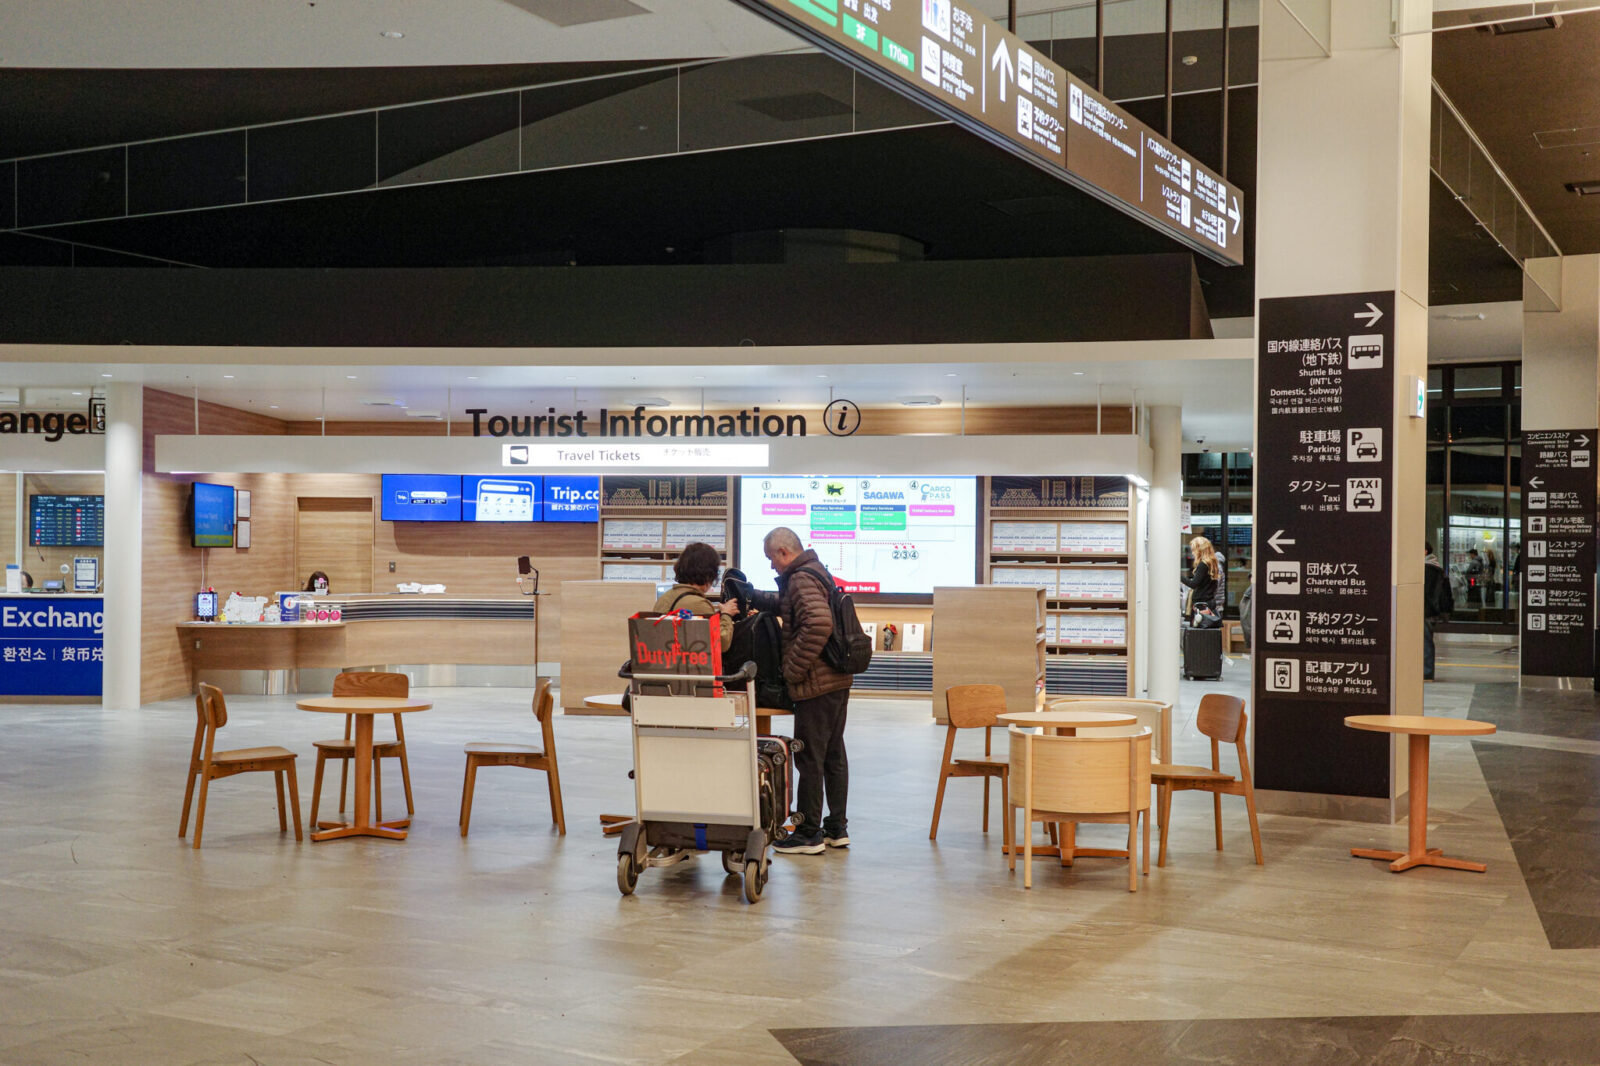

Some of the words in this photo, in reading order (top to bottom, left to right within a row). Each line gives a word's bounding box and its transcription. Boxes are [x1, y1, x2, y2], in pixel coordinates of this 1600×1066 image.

[856, 23, 866, 41] 3F
[889, 44, 908, 66] 170m
[1267, 337, 1342, 353] 国内線連絡バス
[1302, 352, 1342, 367] (地下鉄)
[1299, 369, 1326, 377] Shuttle
[1328, 368, 1342, 376] Bus
[1308, 386, 1342, 396] Subway)
[465, 408, 588, 437] Tourist
[599, 407, 807, 437] Information
[1299, 430, 1341, 444] 駐車場
[1307, 445, 1341, 454] Parking
[557, 450, 594, 461] Travel
[599, 450, 641, 461] Tickets
[1288, 480, 1340, 492] タクシー
[1349, 480, 1378, 488] TAXI
[863, 491, 905, 500] SAGAWA
[1322, 494, 1341, 502] Taxi
[1306, 562, 1359, 575] 団体バス
[1350, 578, 1366, 586] Bus
[1269, 612, 1297, 620] TAXI
[1306, 611, 1378, 625] 予約タクシー
[1306, 627, 1344, 635] Reserved
[3, 646, 47, 662] 환전소
[1305, 660, 1370, 675] 配車アプリ
[1326, 676, 1343, 685] App
[1345, 677, 1372, 686] Pickup
